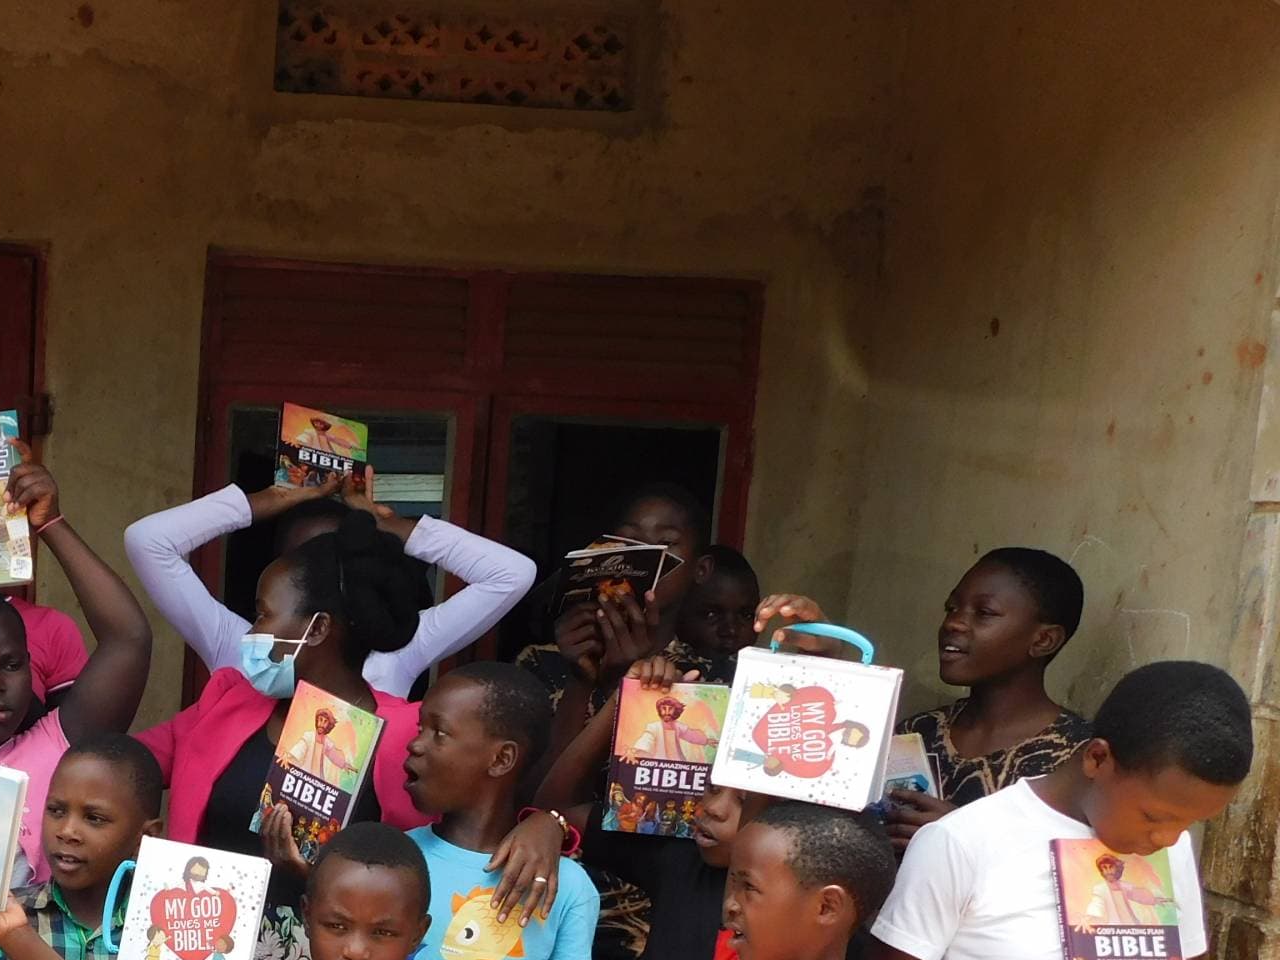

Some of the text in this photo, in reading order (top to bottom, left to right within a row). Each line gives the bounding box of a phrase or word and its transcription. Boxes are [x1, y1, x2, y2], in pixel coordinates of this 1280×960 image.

[298, 449, 354, 475] BIBLE
[767, 712, 791, 756] BIBLE
[790, 705, 802, 762] LOVES ME
[801, 702, 826, 763] MY GOD
[634, 766, 707, 791] BIBLE
[281, 772, 337, 816] BIBLE
[165, 896, 222, 919] MY GOD
[168, 918, 221, 930] LOVES ME
[174, 929, 215, 951] BIBLE
[1094, 936, 1167, 957] BIBLE
